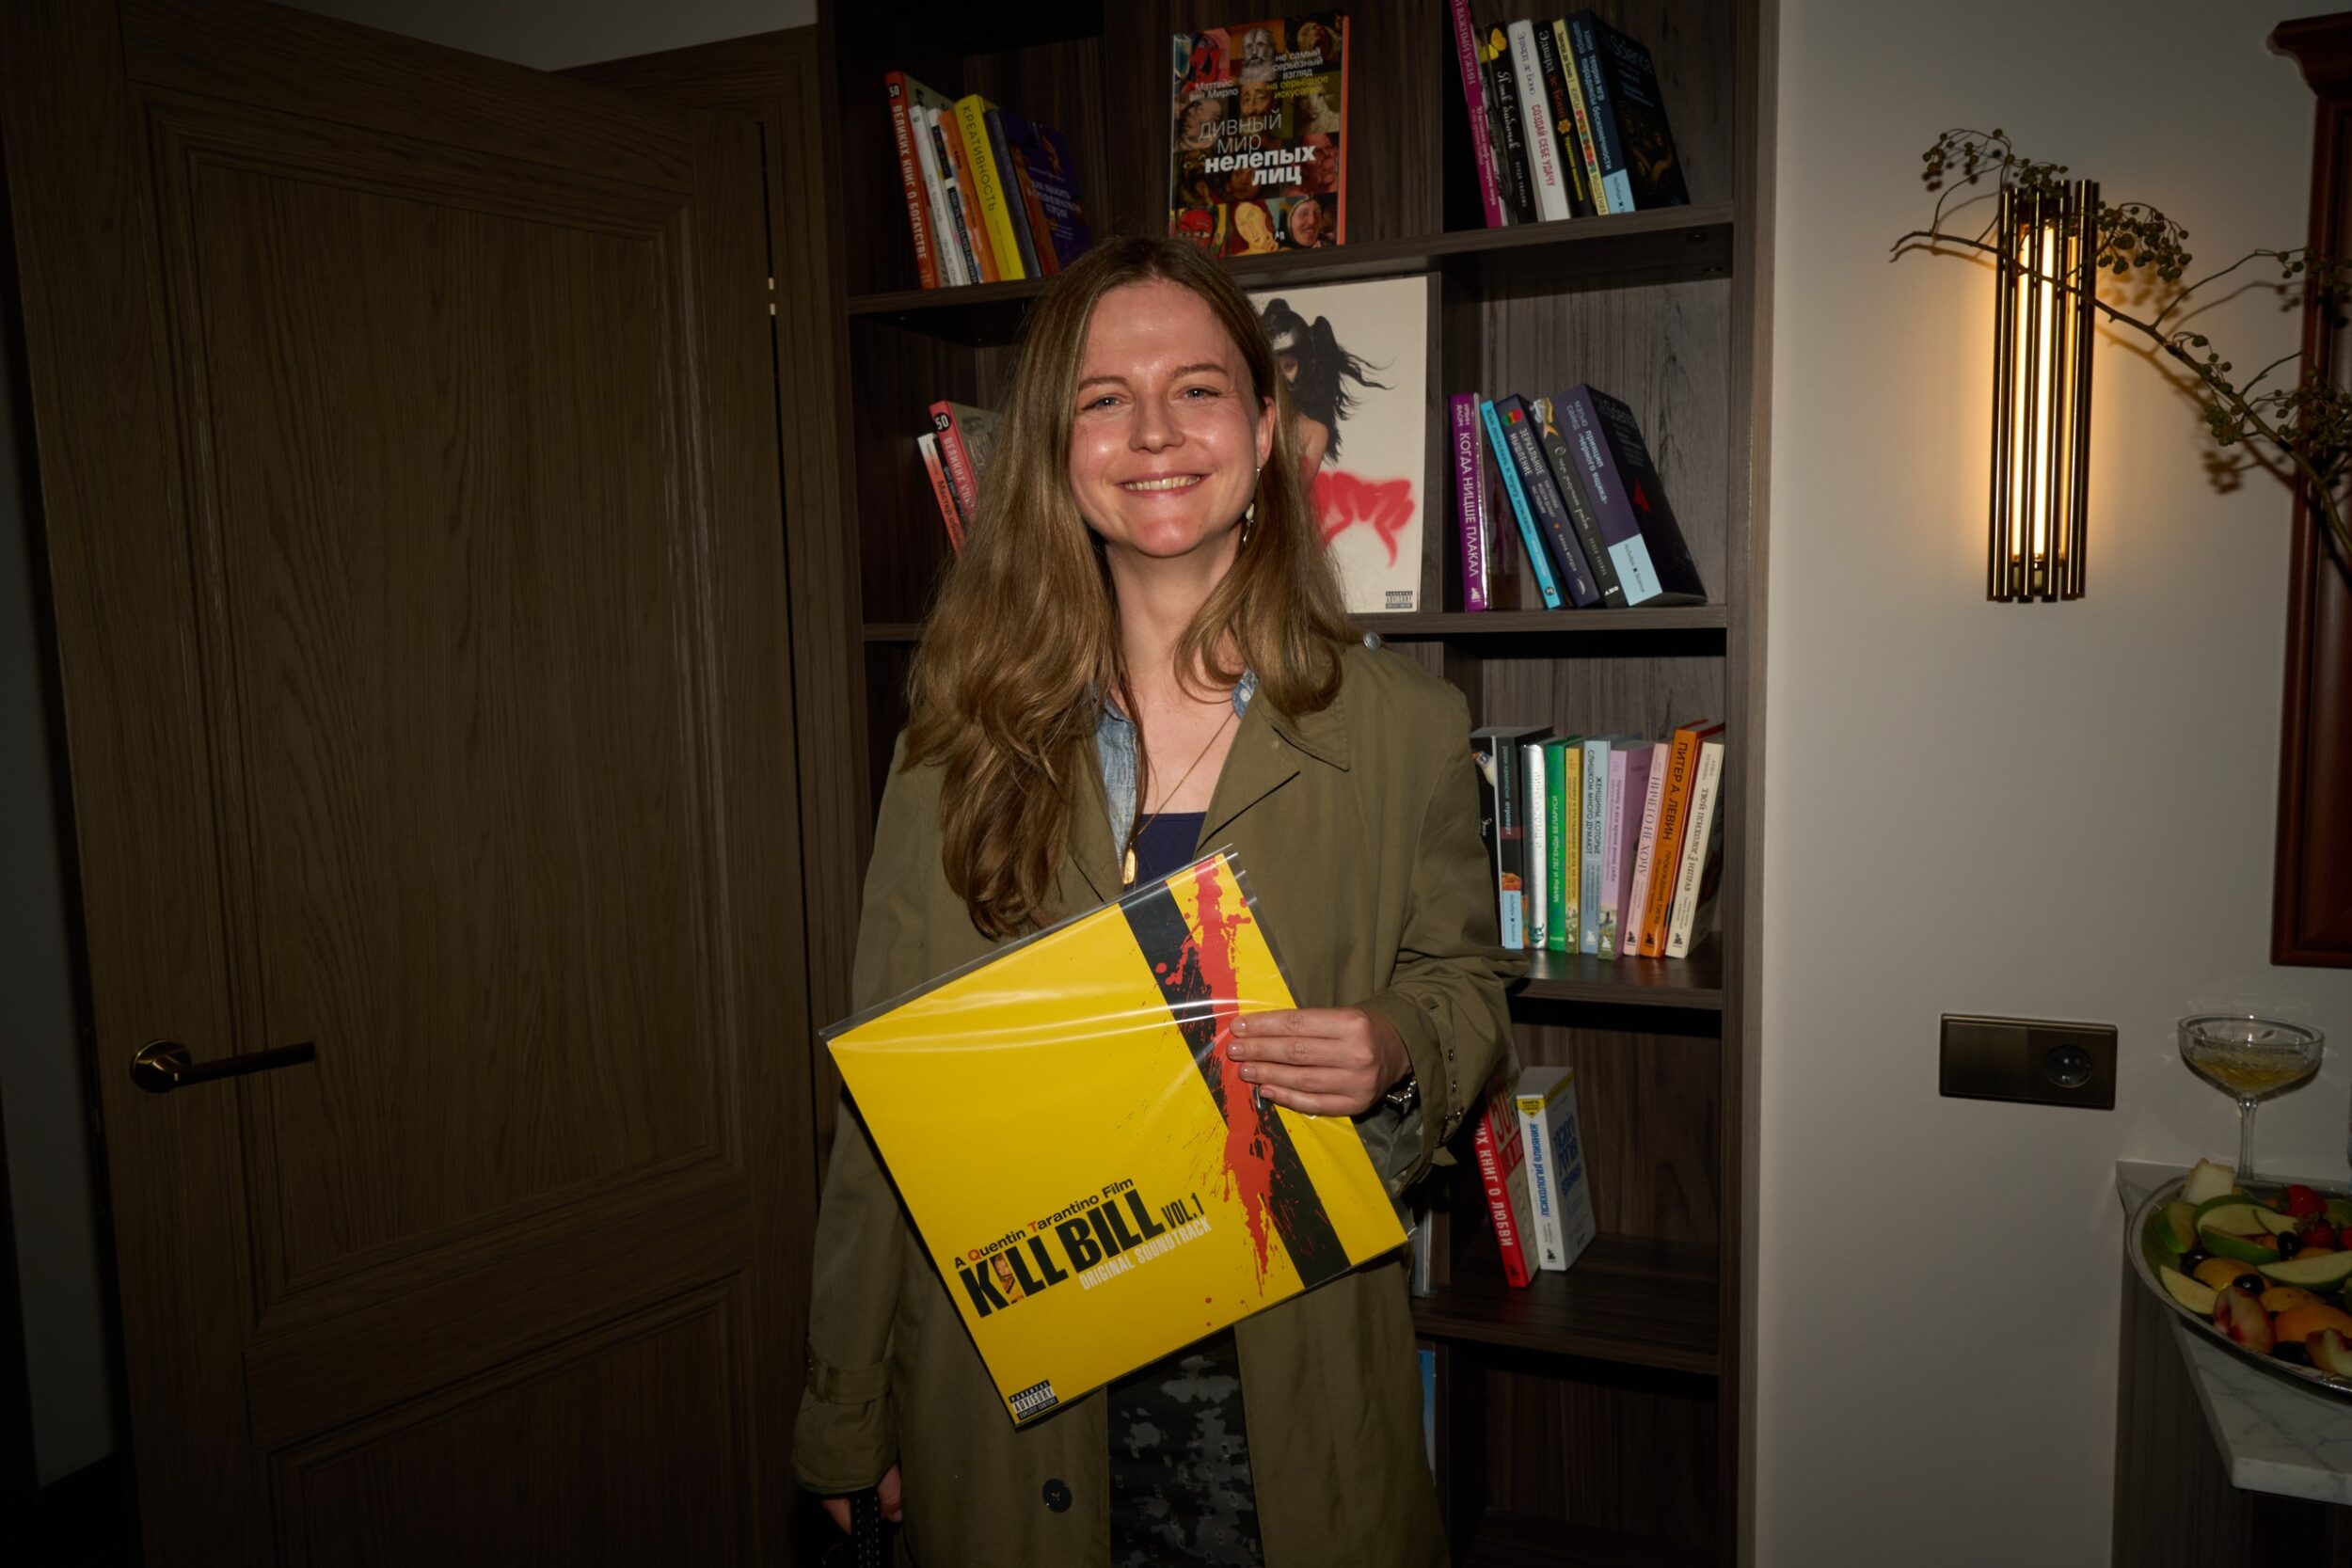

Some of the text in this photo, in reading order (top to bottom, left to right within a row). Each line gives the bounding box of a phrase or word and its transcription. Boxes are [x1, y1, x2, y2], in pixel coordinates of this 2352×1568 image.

[1282, 68, 1312, 80] взгляд
[1463, 53, 1475, 85] УЖИН
[1526, 73, 1534, 95] Боно
[1539, 30, 1565, 119] Эдвард де Боно
[1590, 55, 1605, 101] теория игр
[1476, 105, 1483, 114] 50
[1502, 105, 1520, 149] бабочек
[1581, 58, 1597, 105] парадоксы
[1593, 106, 1612, 169] бесконечности
[961, 105, 994, 211] КРЕАТИВНОСТЬ
[1204, 145, 1316, 174] нелепых
[1532, 104, 1555, 185] СОЗДАЙ СЕБЕ УДАЧУ
[889, 86, 927, 258] 50 ВЕЛИКИХ КНИГ О БОГАТСТВЕ
[1251, 166, 1302, 186] лиц
[935, 415, 949, 430] 50
[943, 436, 966, 483] ВЕЛИКИХ
[1510, 433, 1533, 476] МЫШЛЕНИЕ
[1519, 428, 1545, 474] ЗЕРКАЛЬНОЕ
[1585, 430, 1603, 467] принцип
[1460, 433, 1479, 577] КОГДА НИЦШЕ ПЛАКАЛ
[1645, 777, 1661, 824] НИЧЕГО
[1663, 742, 1688, 840] ПИТЕР А. ЛЕВИН
[1698, 788, 1708, 810] ТВОЙ
[1642, 826, 1653, 839] НЕ
[1690, 813, 1704, 855] ПСИХОЛОГ
[1638, 846, 1650, 874] ХОЧУ
[1529, 1122, 1544, 1162] ВЛИЯНИЯ
[1479, 1149, 1499, 1181] КНИГ
[1491, 1201, 1513, 1246] ЛЮБВИ
[1532, 1164, 1550, 1216] ПСИХОЛОГИЯ
[954, 1178, 1134, 1269] A Quentin Tarantino Film
[958, 1235, 1069, 1319] KILL
[1055, 1189, 1166, 1274] BILL
[1078, 1217, 1212, 1291] ORIGINAL SOUNDTRACK
[1014, 1386, 1055, 1412] ADVISORY
